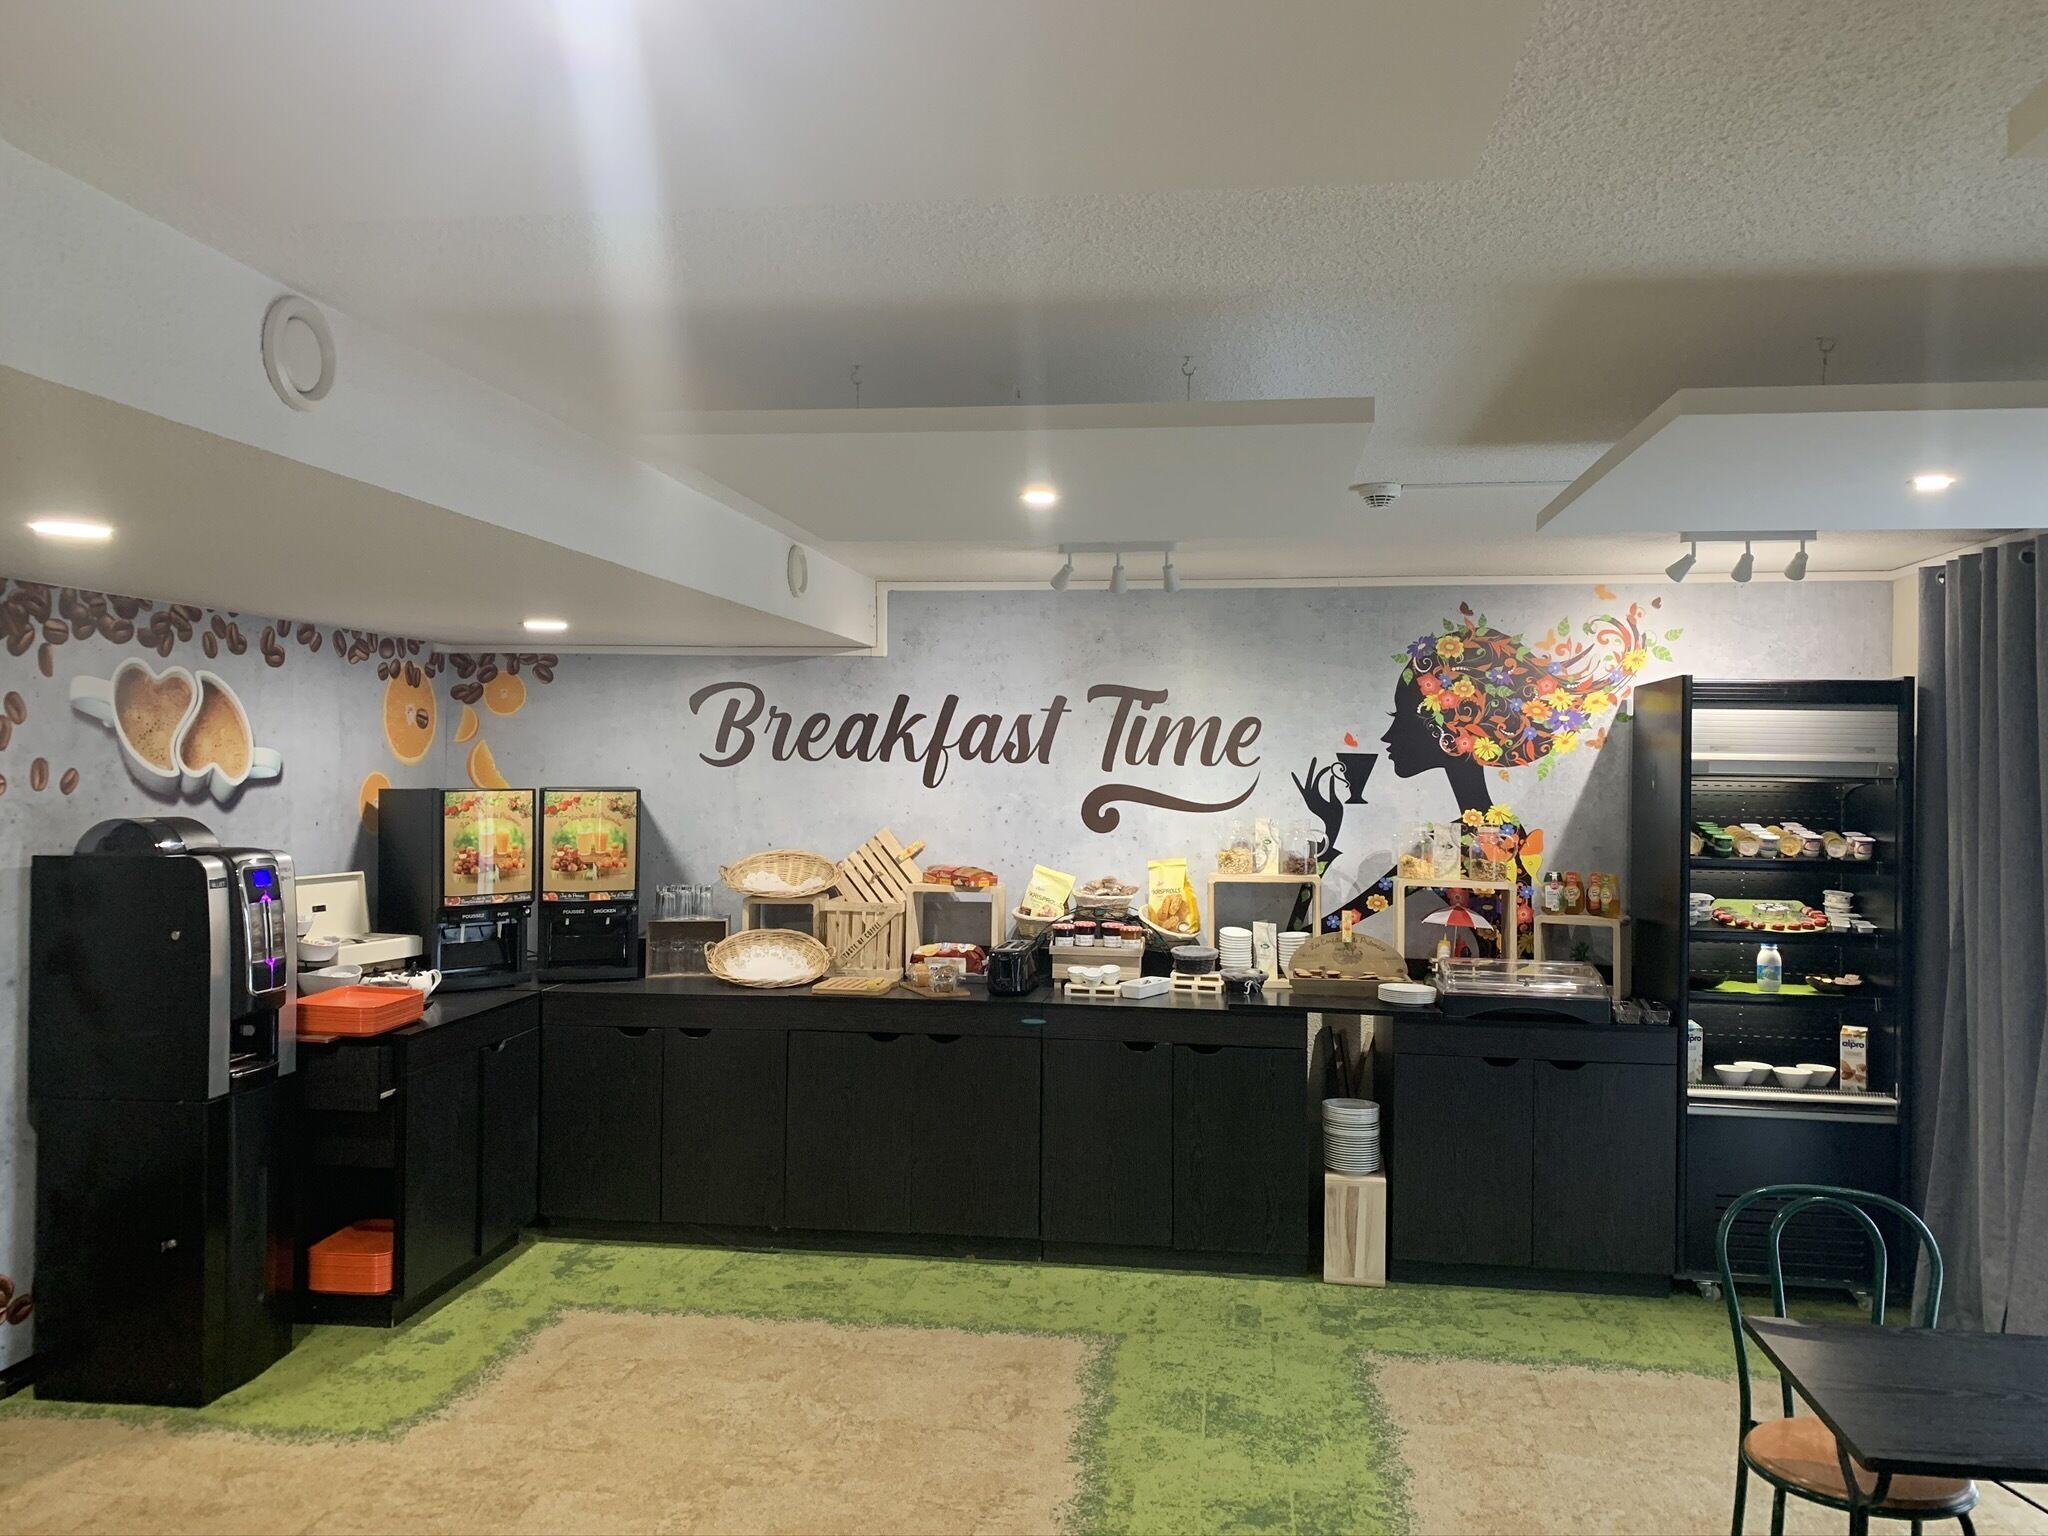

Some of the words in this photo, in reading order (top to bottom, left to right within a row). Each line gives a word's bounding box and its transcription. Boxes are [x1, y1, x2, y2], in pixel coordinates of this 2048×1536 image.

[689, 681, 1072, 788] Breakfast
[1087, 684, 1262, 772] Time
[842, 943, 858, 959] TASTE
[857, 937, 865, 945] OF
[864, 922, 881, 939] COFFEE
[1687, 1034, 1701, 1043] lpro
[1842, 1040, 1865, 1049] alpro
